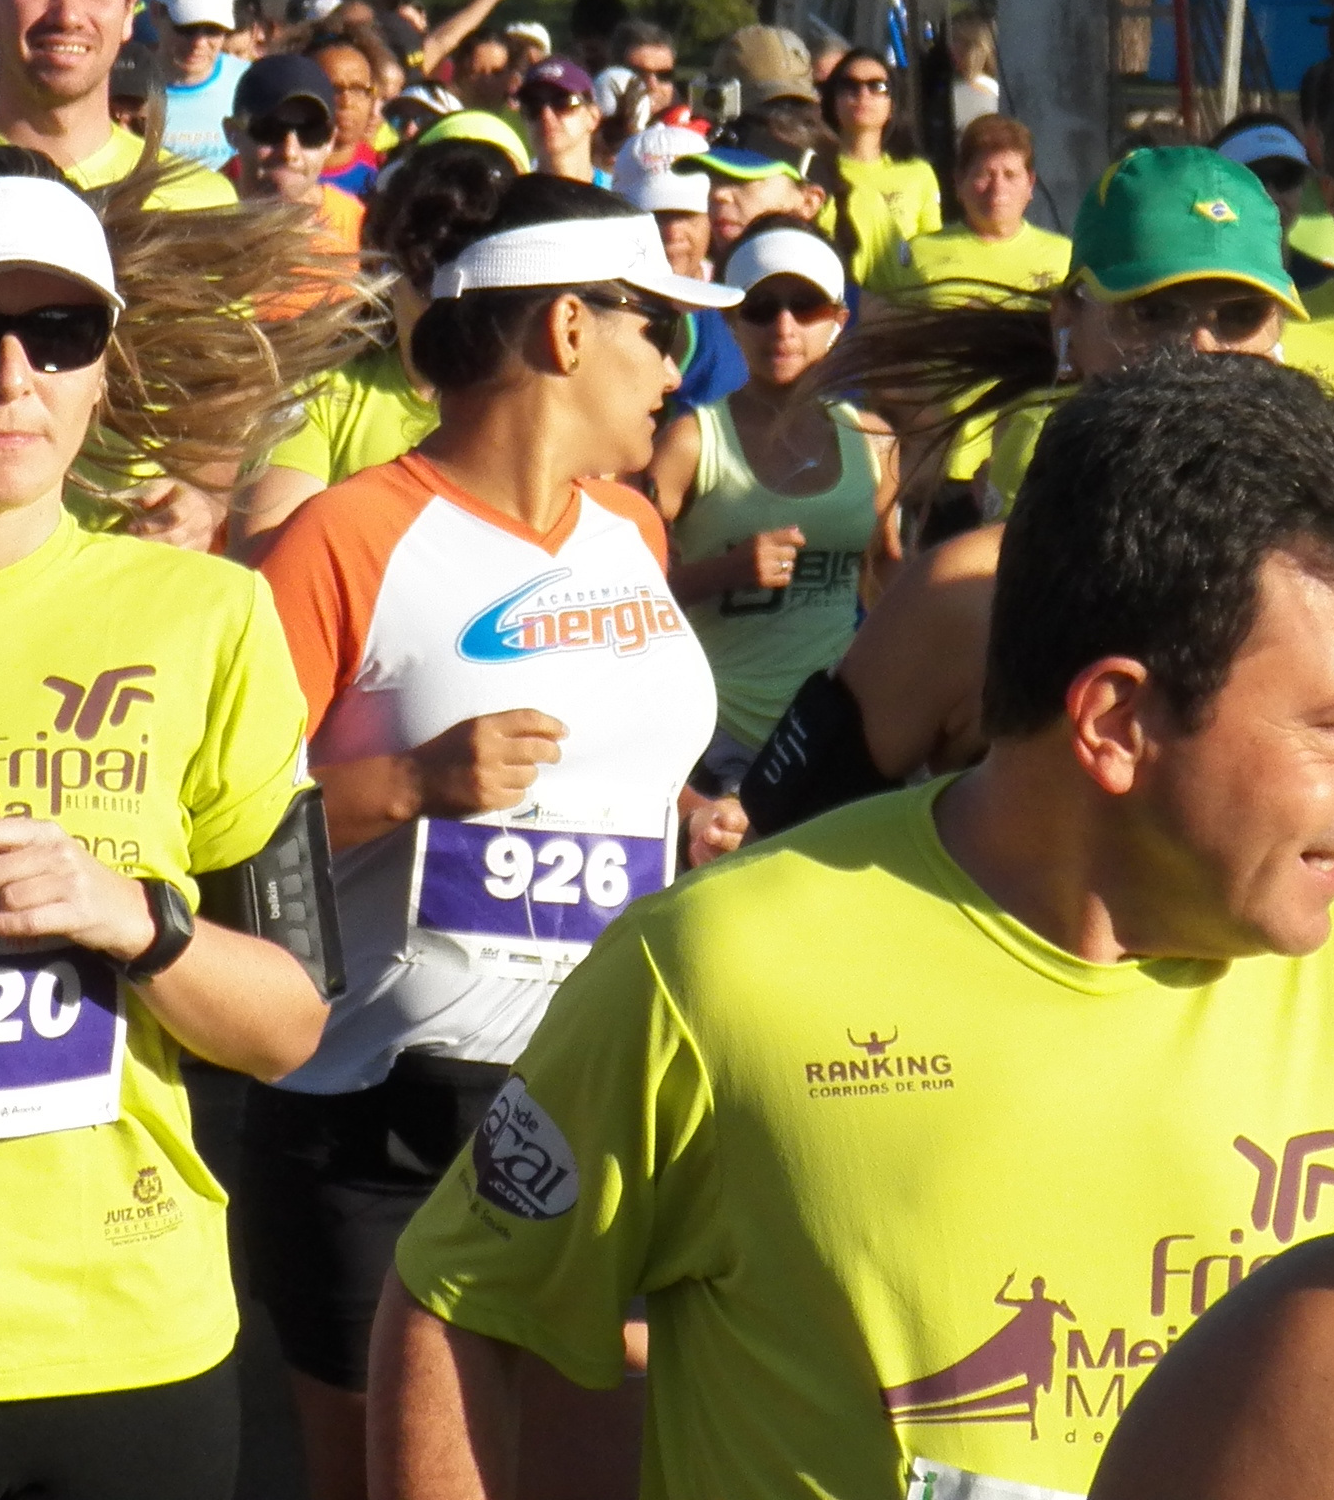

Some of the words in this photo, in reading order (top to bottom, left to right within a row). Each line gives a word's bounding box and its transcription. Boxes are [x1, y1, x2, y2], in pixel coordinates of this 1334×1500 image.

[535, 585, 631, 608] ACADEMIA
[65, 794, 141, 815] ALIMENTOS
[483, 834, 629, 908] 926
[267, 881, 281, 919] belkin
[805, 1054, 953, 1084] RANKING
[809, 1082, 890, 1099] CORRIDAS
[895, 1080, 916, 1092] DE
[921, 1078, 955, 1091] RUA
[104, 1207, 135, 1225] JUIZ
[137, 1206, 155, 1219] DE
